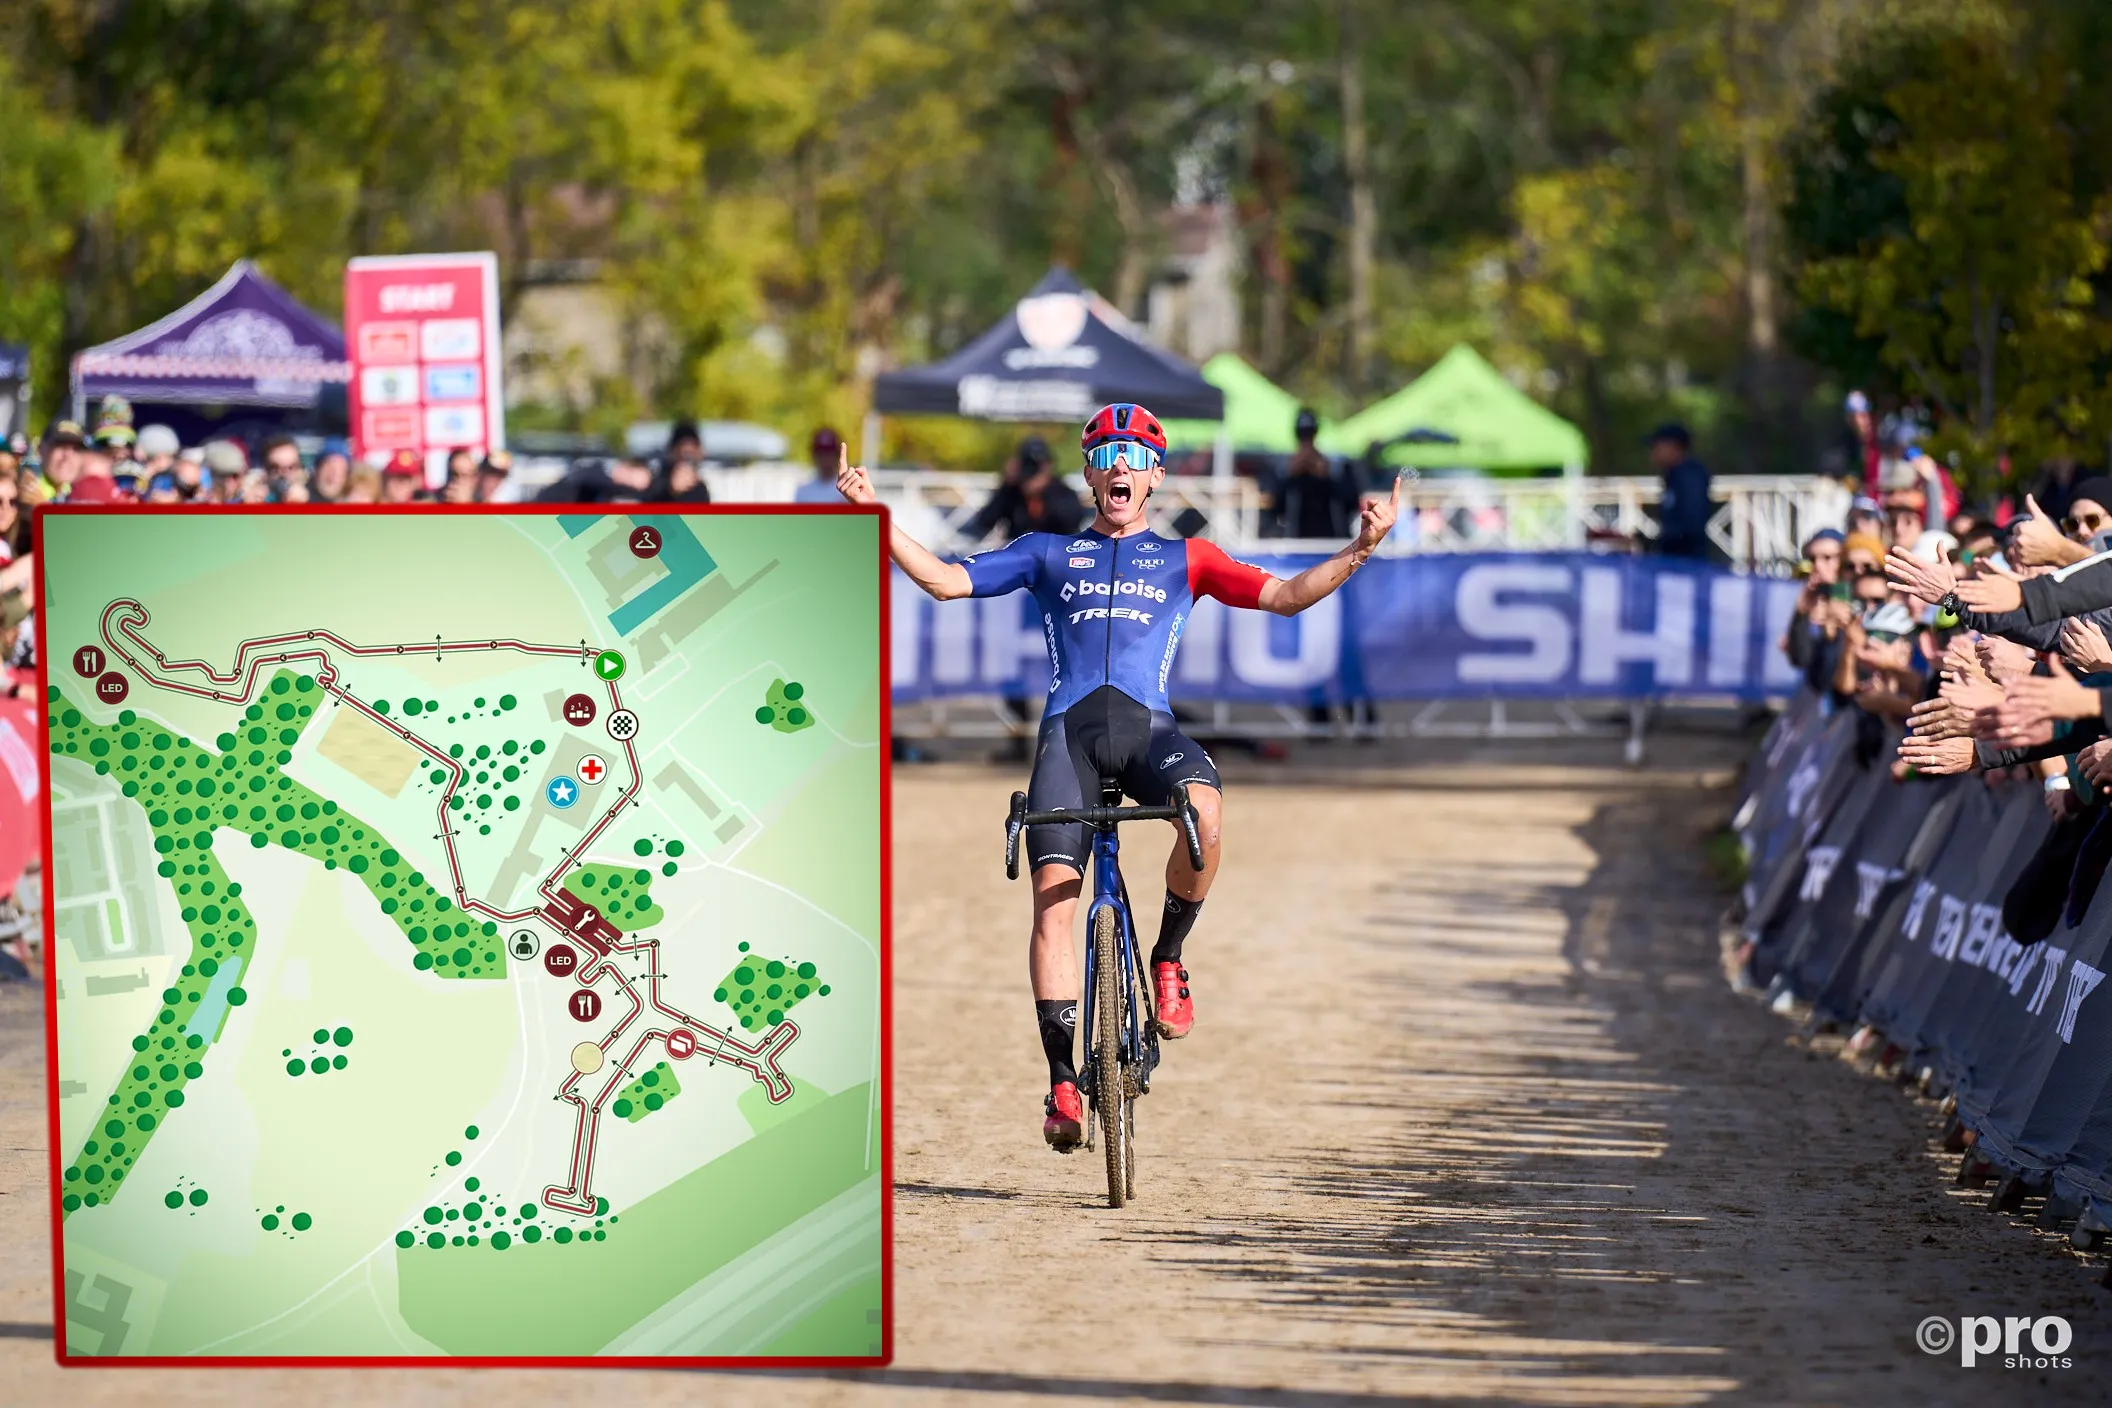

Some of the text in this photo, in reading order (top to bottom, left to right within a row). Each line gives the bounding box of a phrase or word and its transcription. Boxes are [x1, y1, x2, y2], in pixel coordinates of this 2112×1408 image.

[1131, 559, 1164, 570] eggo
[1079, 578, 1167, 604] baloise
[1068, 607, 1154, 625] TREK
[1044, 612, 1060, 678] baloise
[1037, 853, 1075, 862] BONTRAGER
